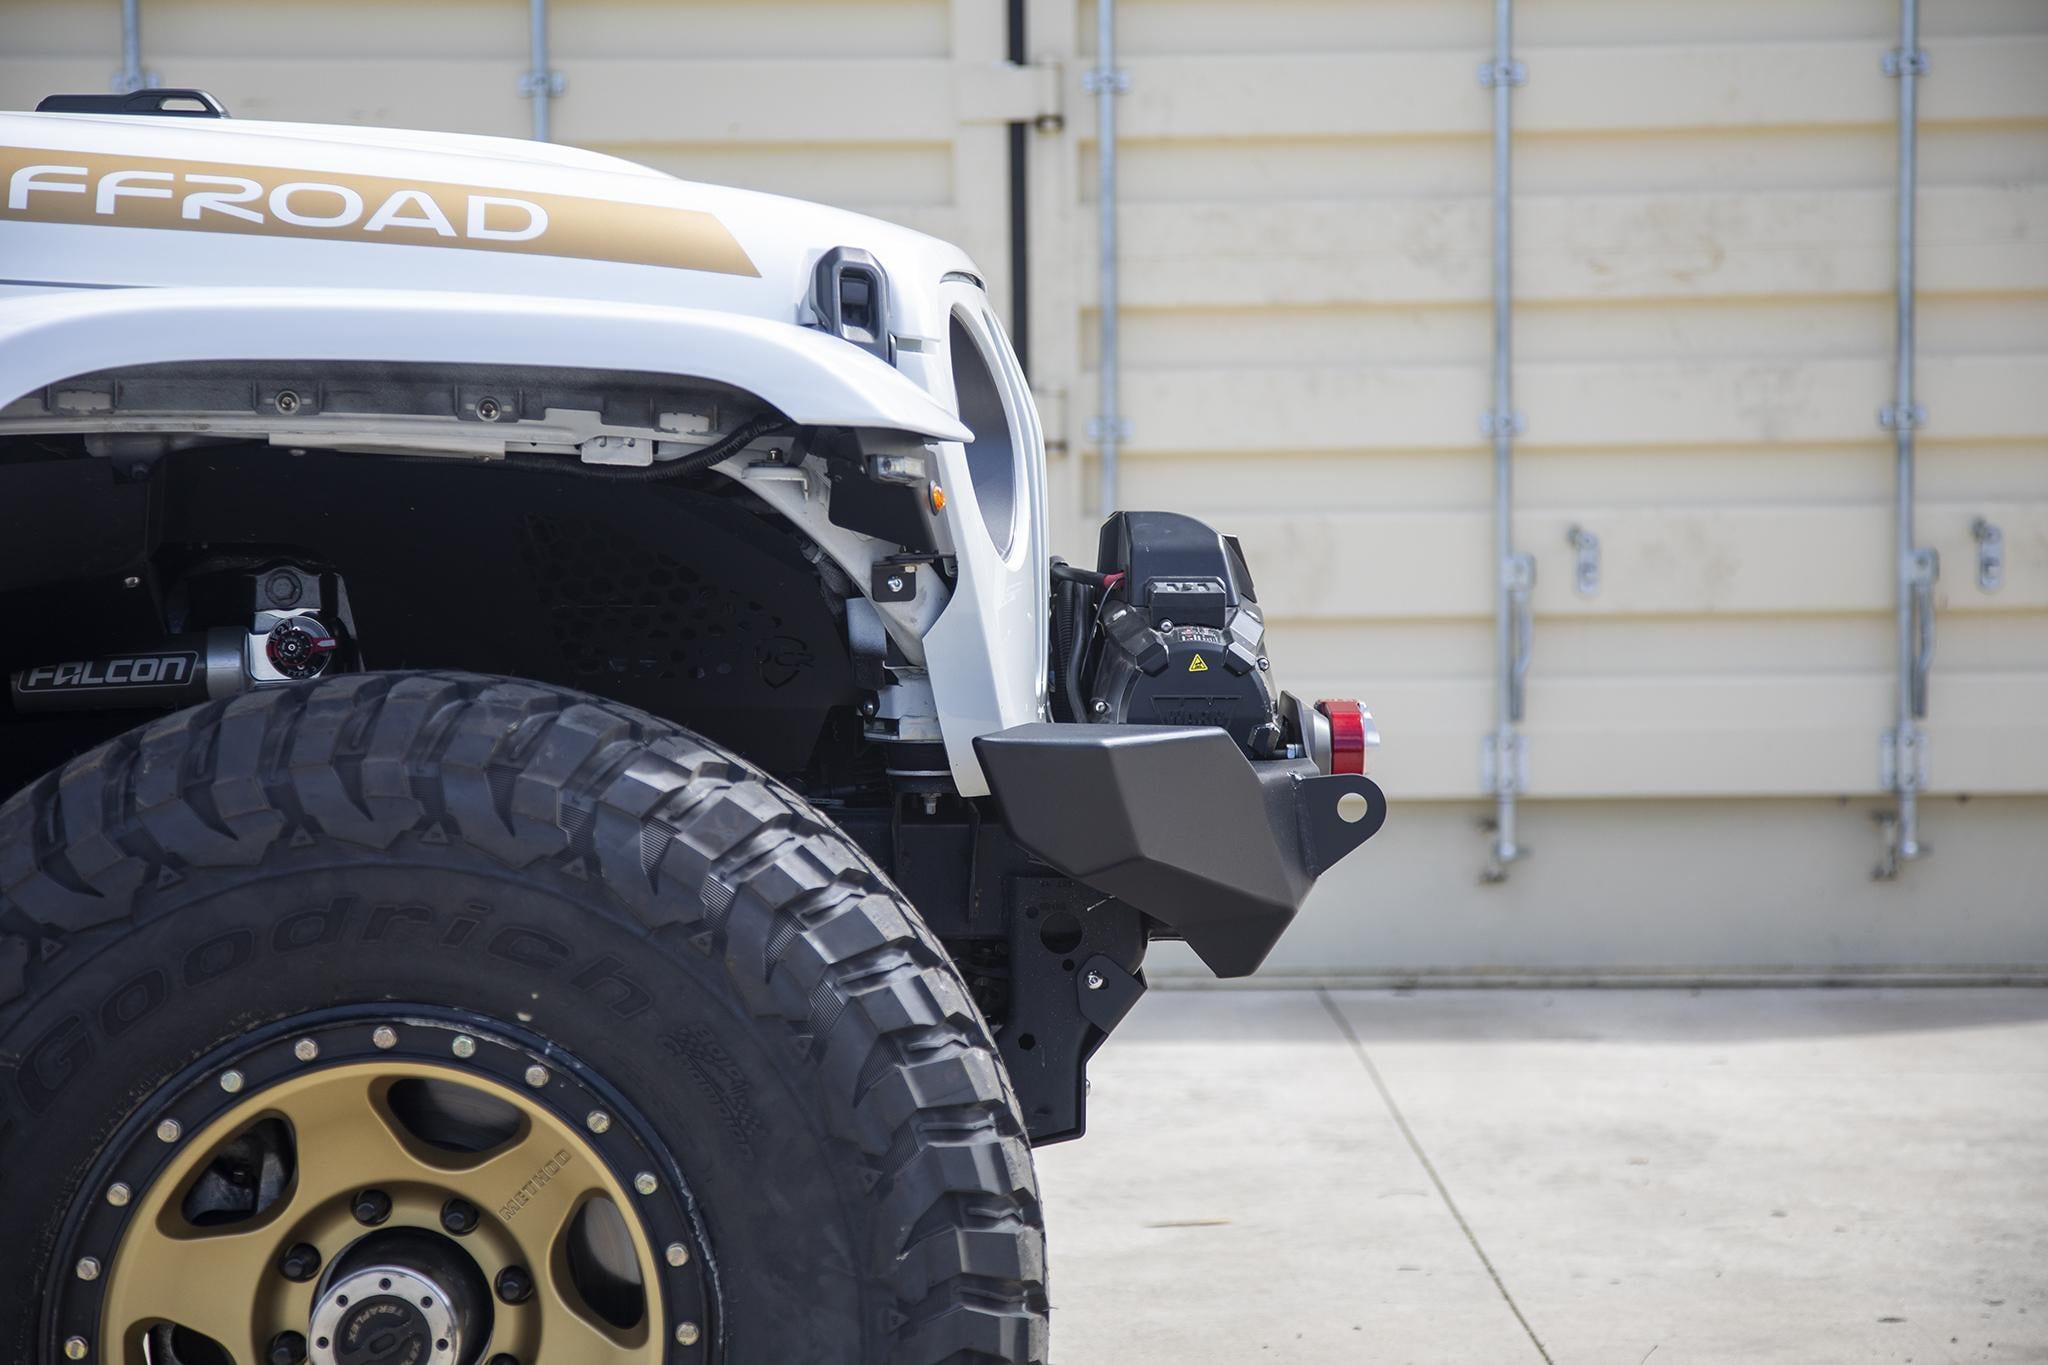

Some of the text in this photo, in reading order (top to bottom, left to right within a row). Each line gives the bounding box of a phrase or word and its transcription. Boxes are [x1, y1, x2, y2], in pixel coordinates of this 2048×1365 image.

[8, 165, 549, 242] FFROAD
[27, 656, 187, 687] FALCON
[0, 893, 654, 1118] Goodrich
[498, 1149, 572, 1223] METHOD
[347, 1304, 405, 1345] TERAPLEX
